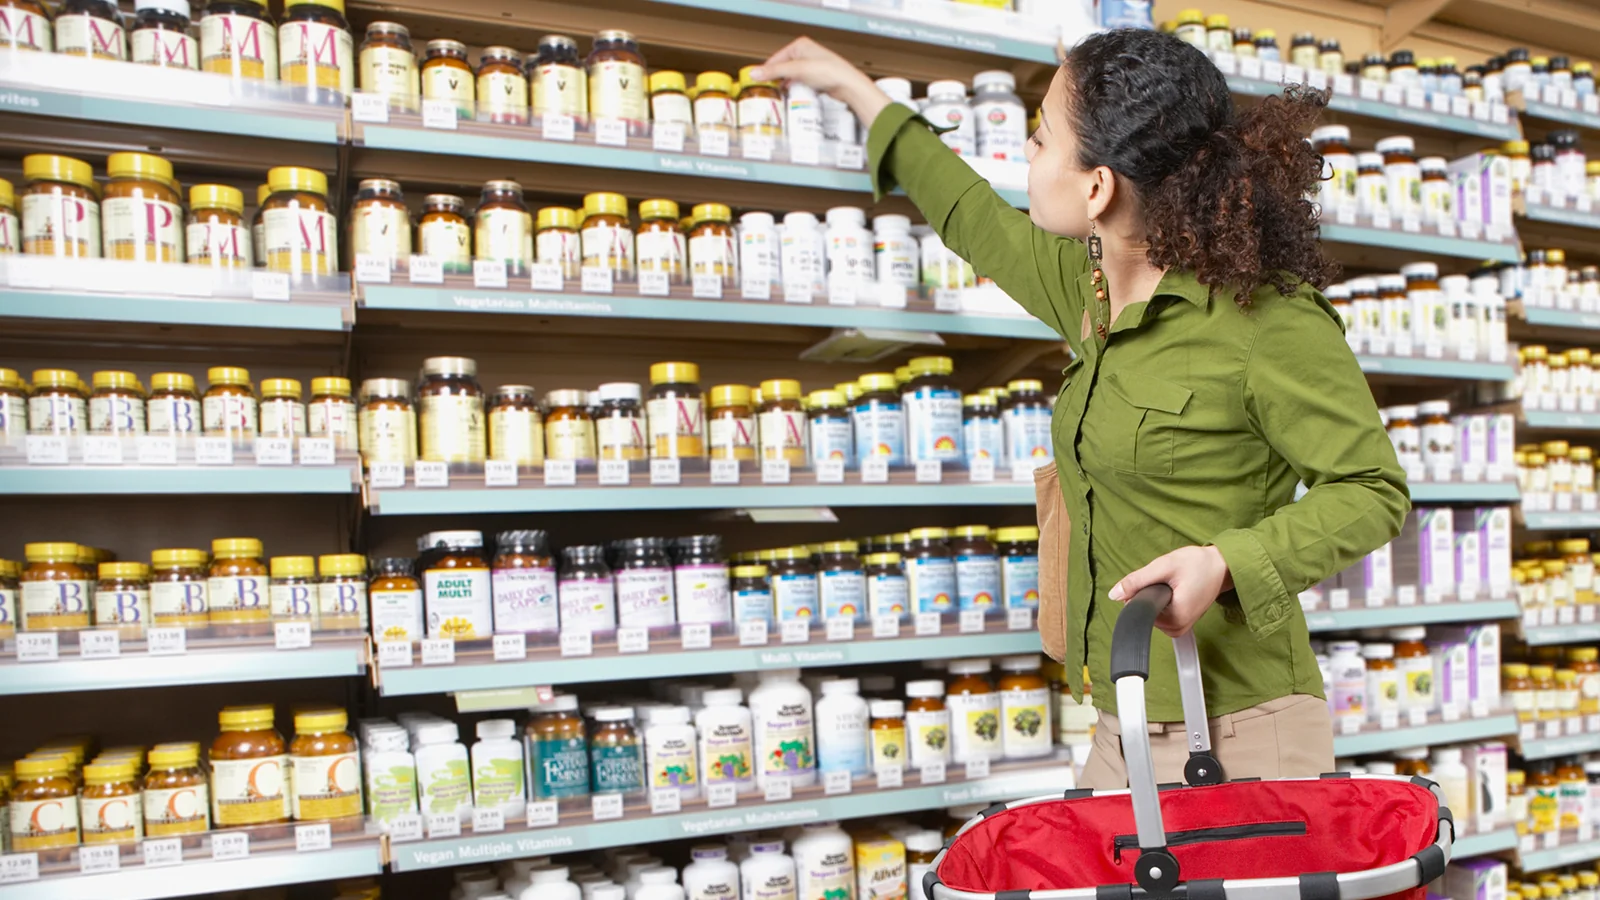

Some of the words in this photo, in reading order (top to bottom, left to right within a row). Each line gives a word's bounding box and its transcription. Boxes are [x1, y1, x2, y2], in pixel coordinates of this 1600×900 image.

[221, 16, 262, 60] M
[299, 23, 338, 68] M
[144, 201, 173, 242] P
[453, 295, 524, 309] Vegetarian
[172, 400, 193, 432] B
[57, 582, 84, 614] B
[183, 583, 206, 614] B
[236, 578, 261, 608] B
[336, 585, 359, 614] B
[437, 579, 472, 589] ADULT
[438, 589, 472, 599] MULTI
[115, 592, 141, 624] B
[290, 586, 312, 616] B
[762, 651, 792, 664] Multi
[796, 649, 843, 662] Vitamins
[248, 761, 282, 799] C
[327, 756, 359, 795] C
[30, 800, 64, 833] C
[98, 800, 130, 832] C
[168, 789, 199, 820] C
[681, 814, 744, 834] Vegetarian
[745, 806, 819, 825] Multivitamins
[413, 850, 454, 865] Vegan
[459, 841, 514, 858] Multiple
[517, 835, 573, 851] Vitamins
